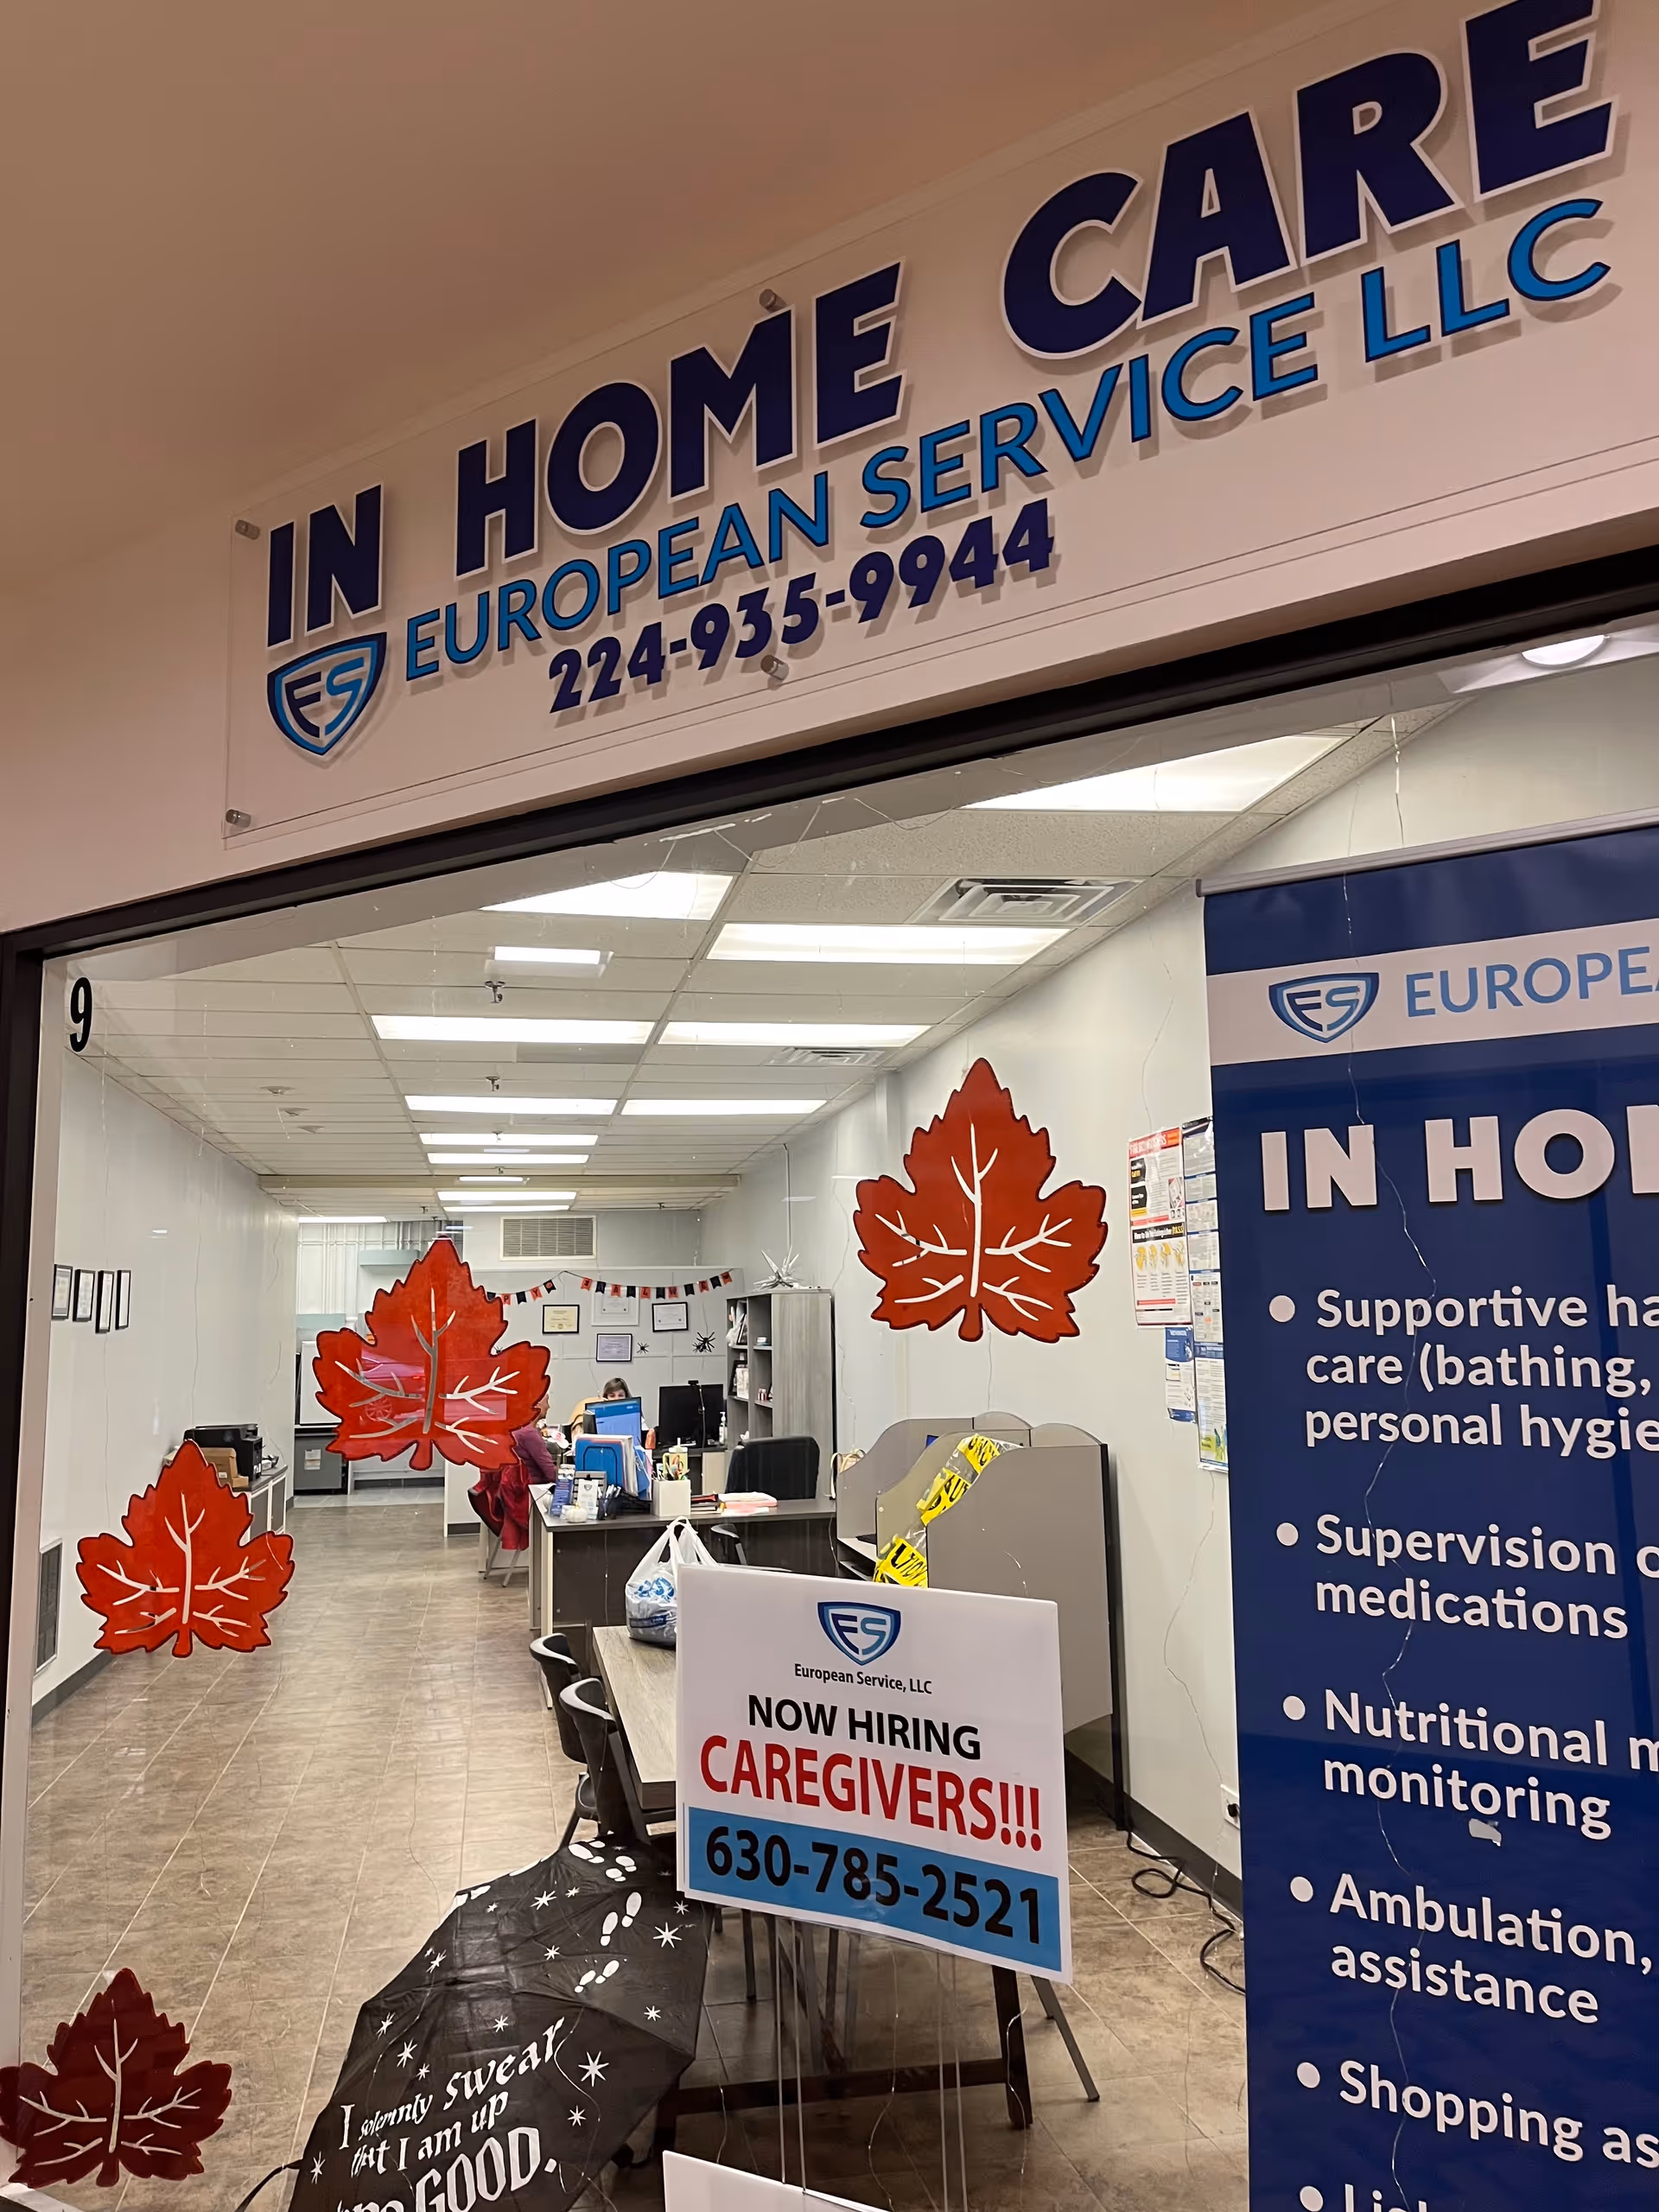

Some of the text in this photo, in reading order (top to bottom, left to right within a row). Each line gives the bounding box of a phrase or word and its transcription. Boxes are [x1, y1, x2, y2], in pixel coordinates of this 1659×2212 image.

[266, 0, 1613, 649] IN HOME CARE
[405, 198, 1612, 683] EUROPEAN SERVICE LLC
[548, 497, 1056, 715] 224-935-9944
[69, 976, 93, 1052] 9
[1405, 945, 1659, 1018] EUROPE
[1261, 1123, 1378, 1211] IN
[1424, 1103, 1659, 1203] HO
[1315, 1285, 1588, 1336] Supportive
[1306, 1342, 1651, 1398] care (bathing,
[1306, 1402, 1503, 1447] personal
[1315, 1513, 1617, 1576] Supervision
[1316, 1576, 1629, 1640] medications
[794, 1662, 933, 1694] European Service, LLC
[748, 1694, 982, 1761] NOW HIRING
[1324, 1688, 1608, 1767] Nutritional
[699, 1734, 1043, 1853] CAREGIVERS!!!
[1323, 1757, 1612, 1840] monitoring
[705, 1825, 1041, 1946] 630-785-2521
[1329, 1872, 1654, 1976] Ambulation,
[1331, 1943, 1599, 2024] assistance
[339, 2103, 355, 2151] I
[442, 2016, 565, 2111] swear
[1339, 2059, 1584, 2162] Shopping
[397, 2136, 411, 2172] I
[417, 2120, 462, 2160] am
[470, 2090, 509, 2133] up
[415, 2126, 557, 2212] GOOD.
